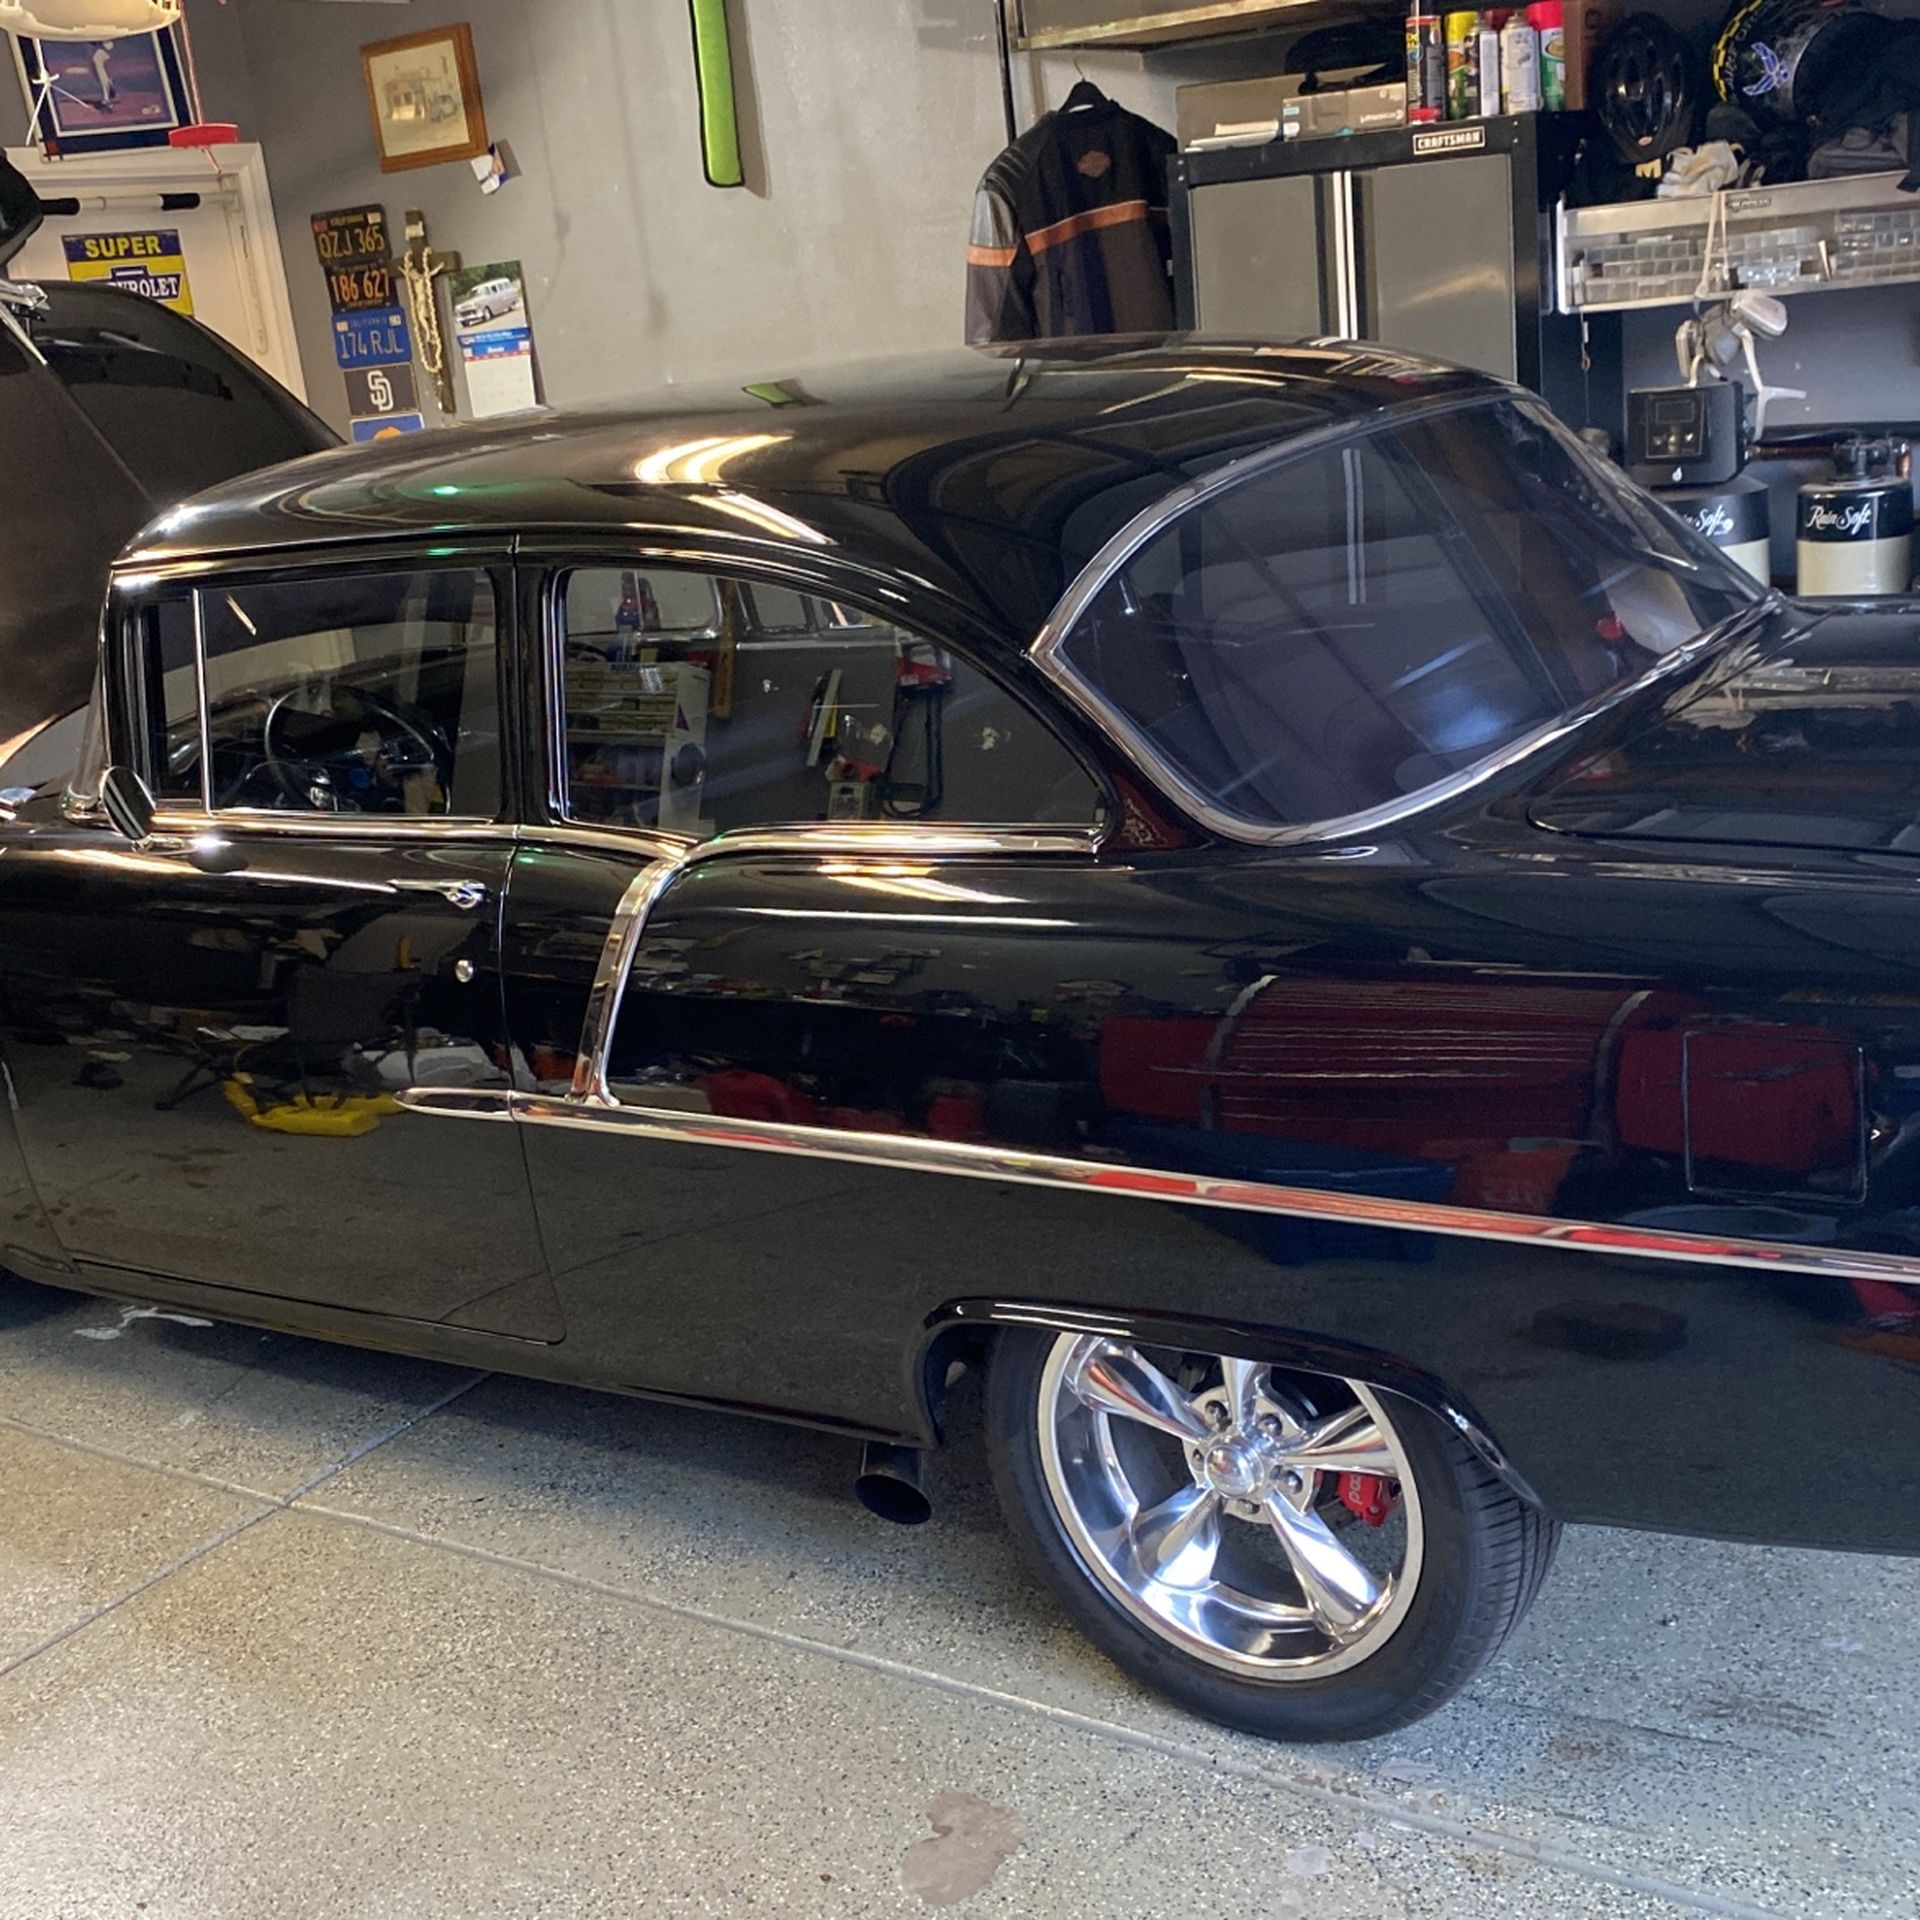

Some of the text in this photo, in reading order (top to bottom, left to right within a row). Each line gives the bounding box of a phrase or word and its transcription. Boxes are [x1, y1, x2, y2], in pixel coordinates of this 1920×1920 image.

[1417, 131, 1481, 149] CRAFTSMAN
[84, 235, 162, 258] SUPER
[354, 225, 385, 253] 365
[330, 273, 359, 304] 186
[340, 328, 405, 359] 174 RJL
